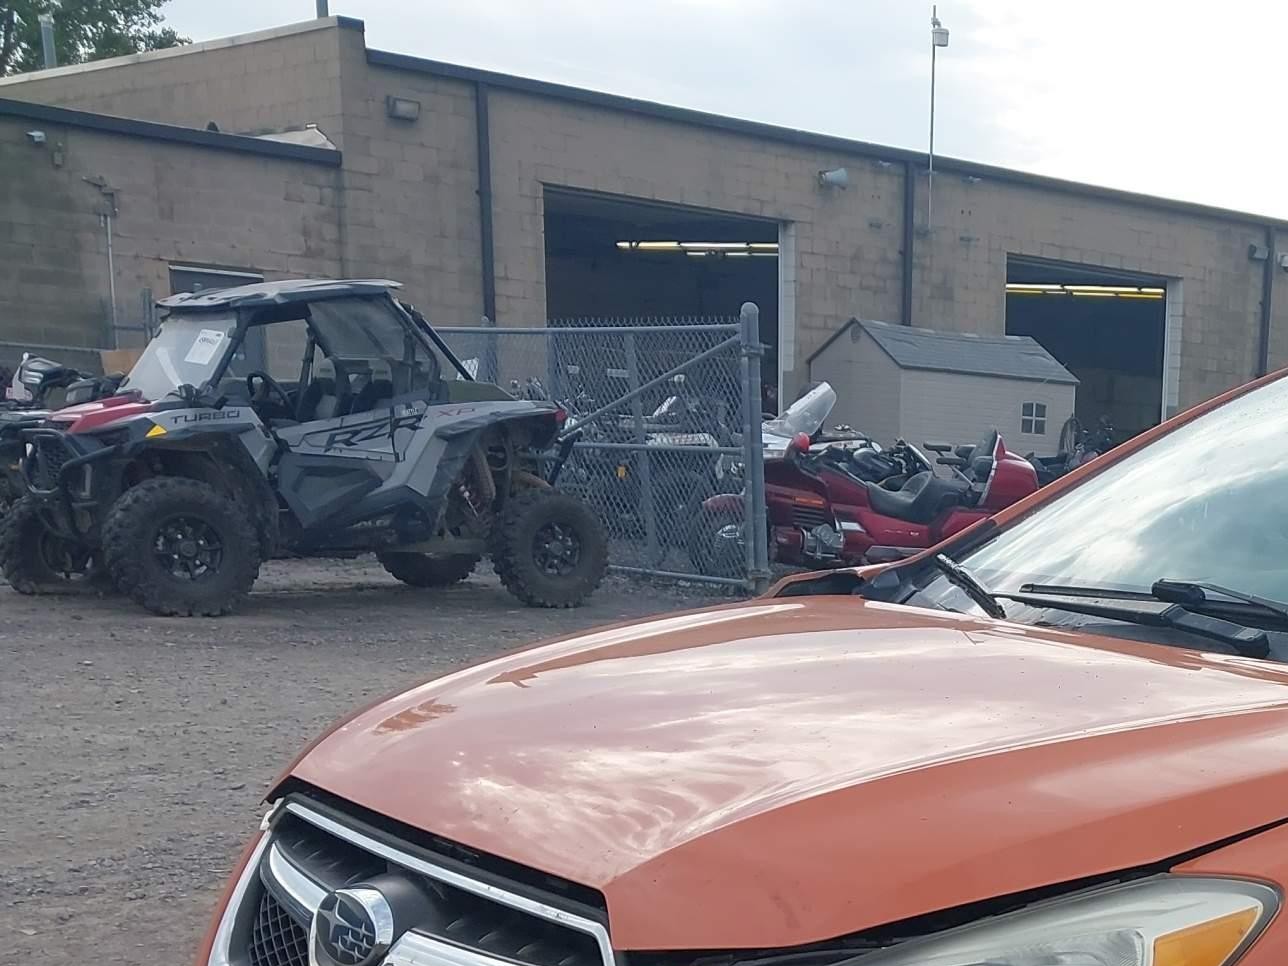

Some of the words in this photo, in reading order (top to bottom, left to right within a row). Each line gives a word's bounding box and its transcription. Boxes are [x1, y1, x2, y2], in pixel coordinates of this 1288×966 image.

[171, 410, 240, 424] TURBO
[438, 408, 475, 418] XP
[324, 415, 427, 453] RZR
